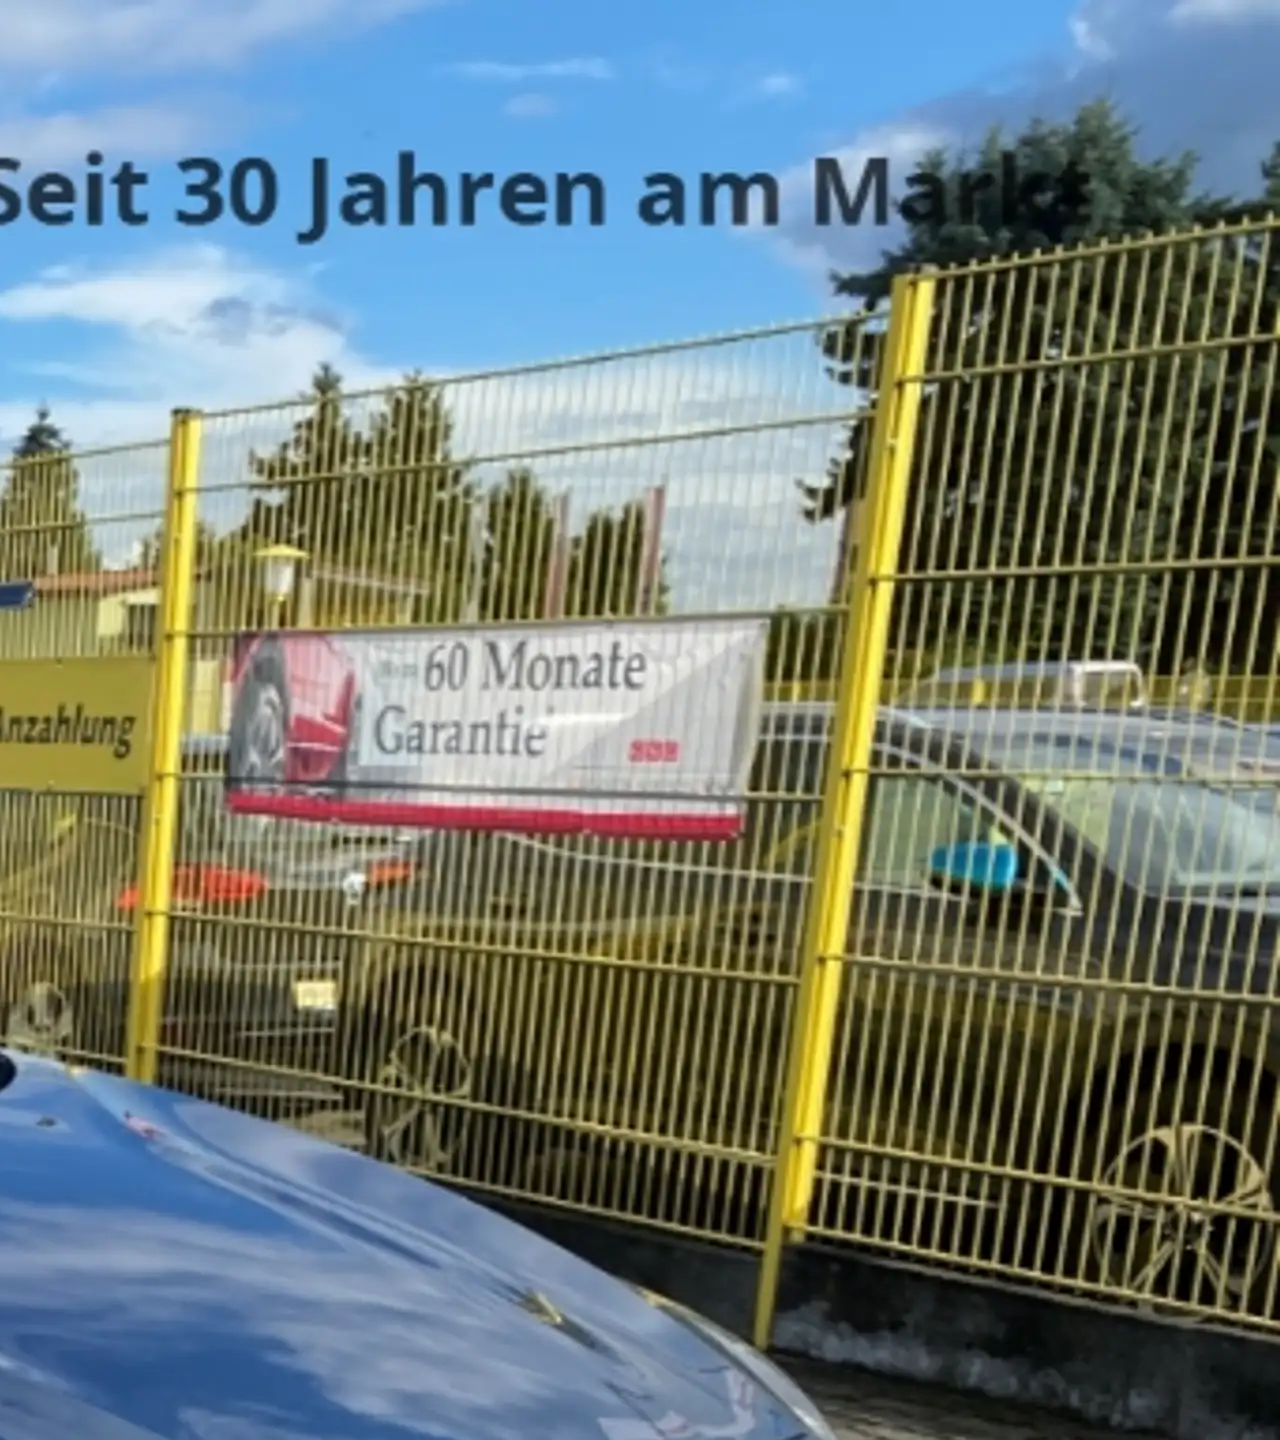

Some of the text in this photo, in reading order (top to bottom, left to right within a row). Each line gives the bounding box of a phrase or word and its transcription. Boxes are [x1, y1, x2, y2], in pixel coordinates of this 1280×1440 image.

[424, 640, 647, 692] 60 Monate
[374, 705, 549, 758] Garantie
